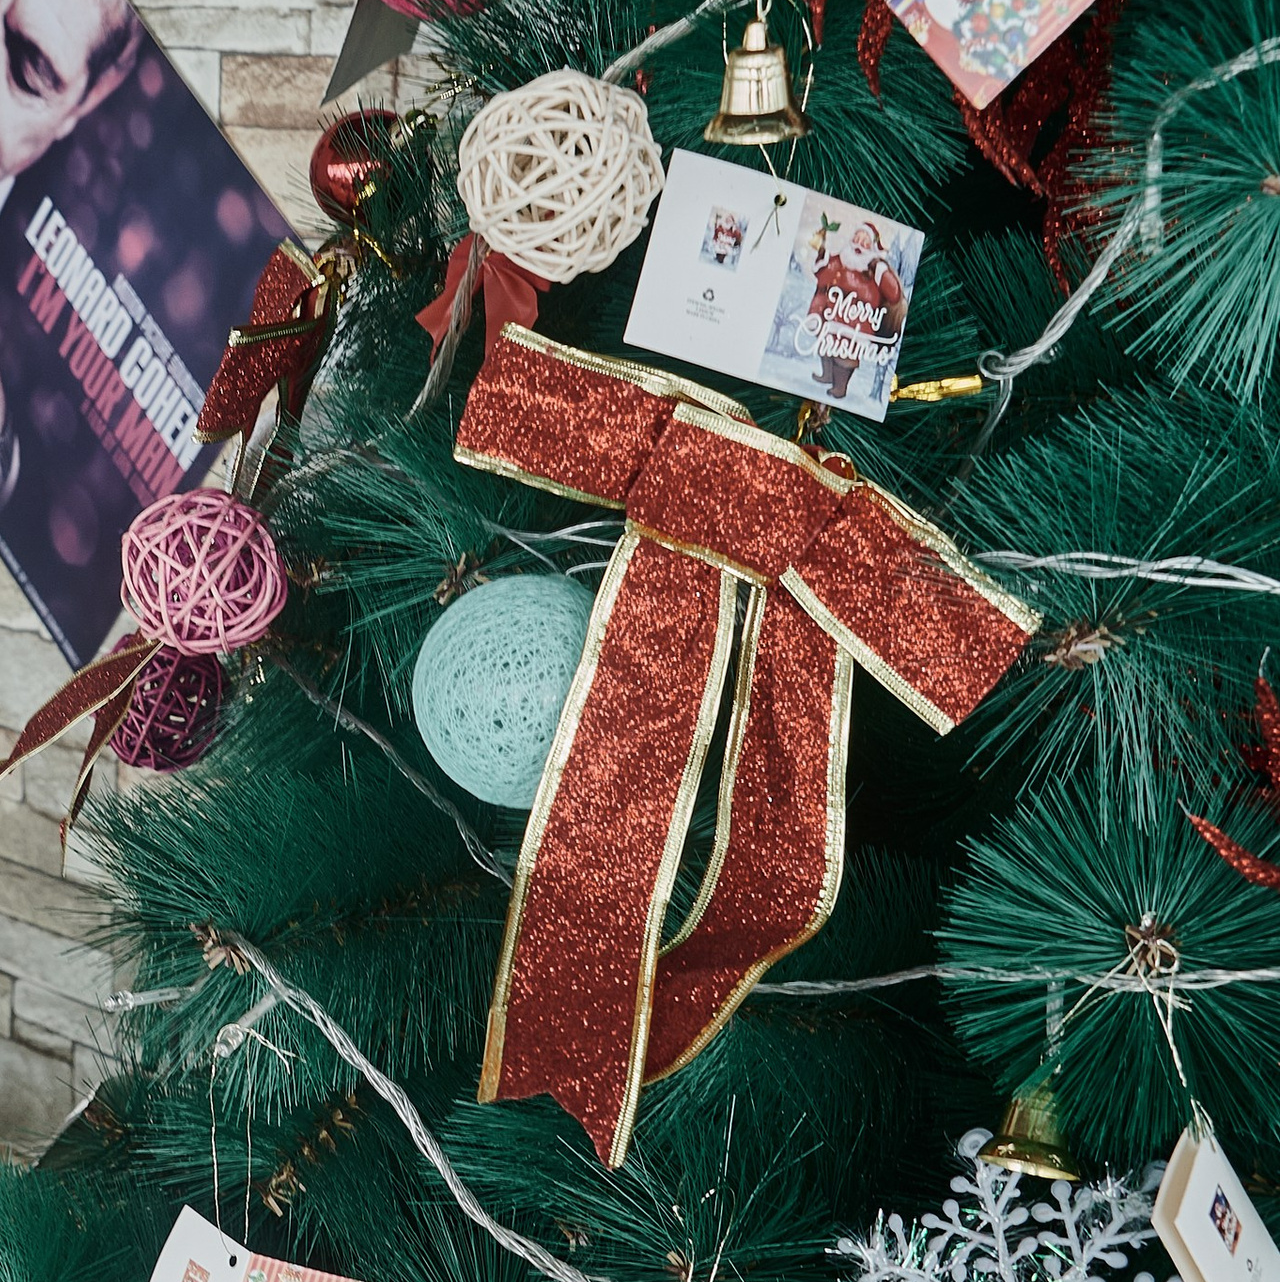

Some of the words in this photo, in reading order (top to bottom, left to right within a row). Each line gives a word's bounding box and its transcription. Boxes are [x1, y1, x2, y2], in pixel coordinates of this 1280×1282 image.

[24, 195, 134, 360] LEONARD
[119, 335, 205, 473] COHEN
[789, 312, 899, 367] Christmas
[822, 285, 888, 332] Merry
[58, 309, 127, 422] YOUR
[114, 397, 188, 503] MAN
